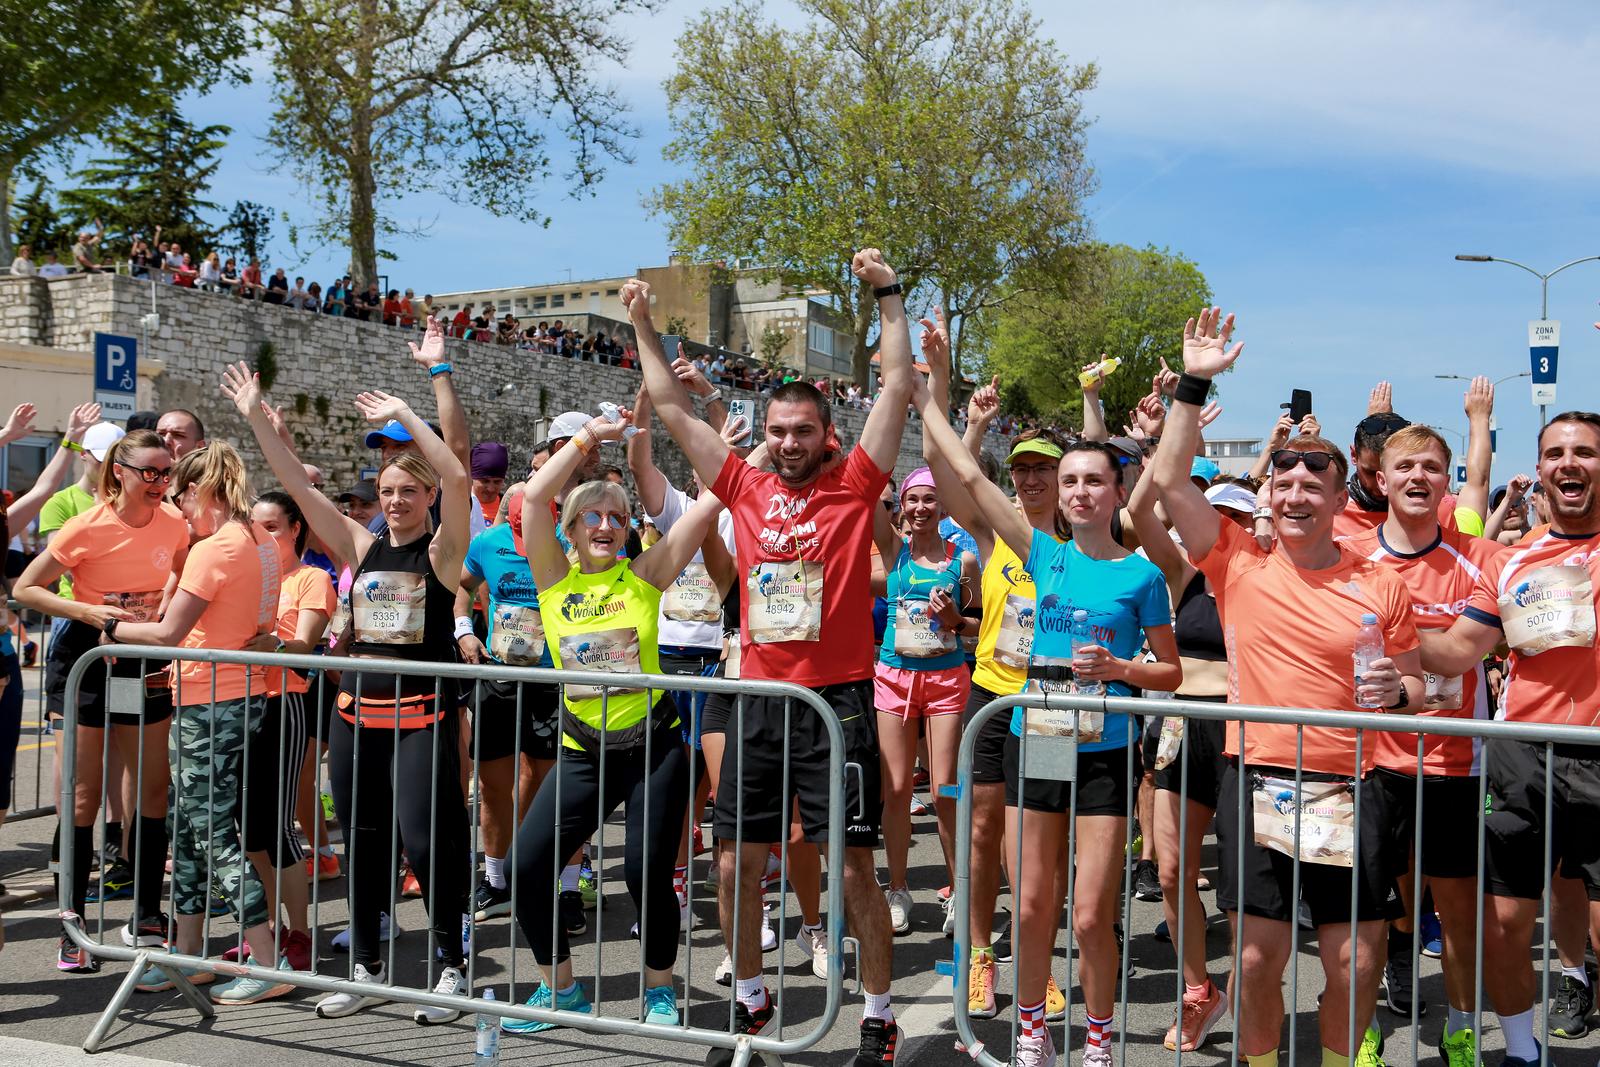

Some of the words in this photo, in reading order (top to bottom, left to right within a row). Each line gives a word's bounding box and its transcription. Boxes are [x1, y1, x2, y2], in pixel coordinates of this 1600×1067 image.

[1535, 326, 1554, 335] ZONA
[107, 344, 126, 381] P
[1539, 356, 1549, 373] 3
[1460, 470, 1466, 479] 4
[795, 537, 820, 550] SVE
[679, 592, 704, 601] 47320
[765, 603, 795, 615] 48942
[372, 611, 400, 621] 53351
[1527, 610, 1561, 628] 50707
[502, 634, 526, 646] 47798
